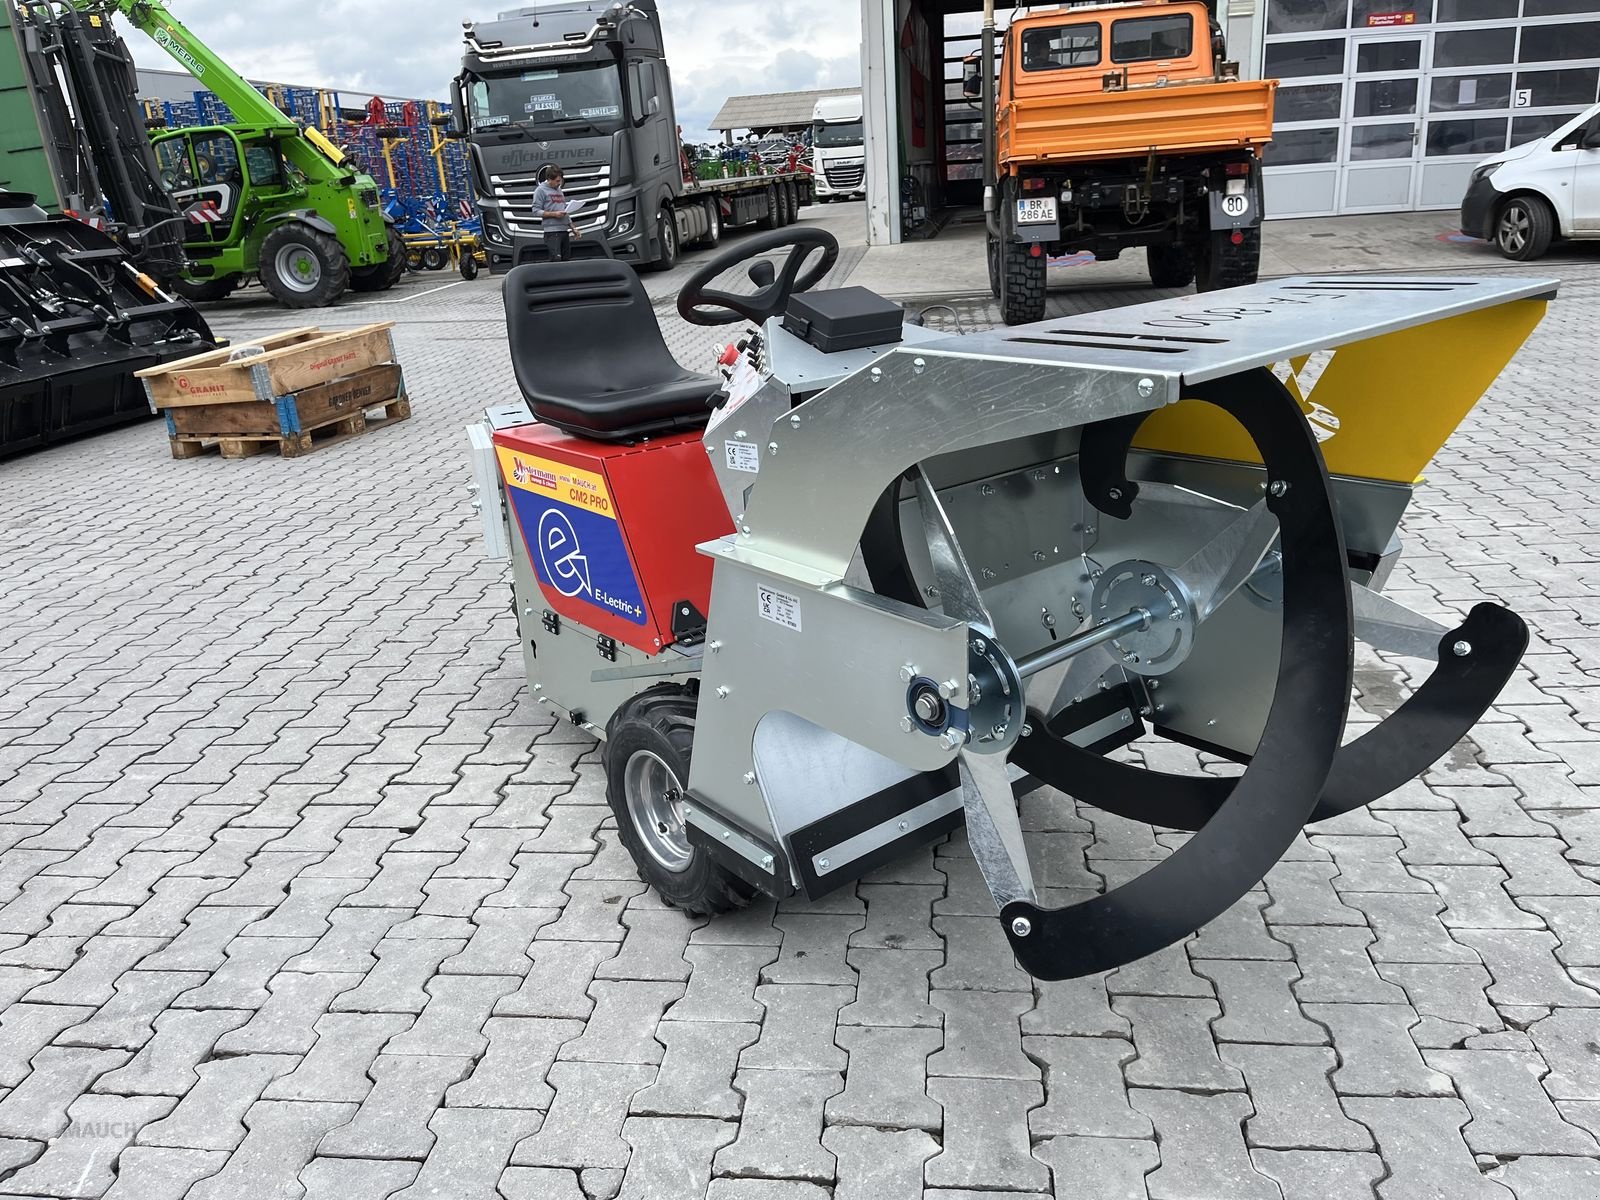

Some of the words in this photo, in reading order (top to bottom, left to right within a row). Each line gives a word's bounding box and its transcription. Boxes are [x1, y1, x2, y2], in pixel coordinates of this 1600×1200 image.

[170, 40, 205, 73] MERLO
[534, 101, 560, 111] ALESSIO
[1517, 91, 1527, 106] 5
[1030, 200, 1042, 210] BR
[1227, 197, 1243, 212] 80
[1020, 210, 1040, 220] 286
[1041, 209, 1054, 219] AE
[190, 384, 225, 394] GRANIT
[569, 487, 588, 505] CM2
[589, 494, 609, 511] PRO
[595, 588, 633, 614] E-Lectric
